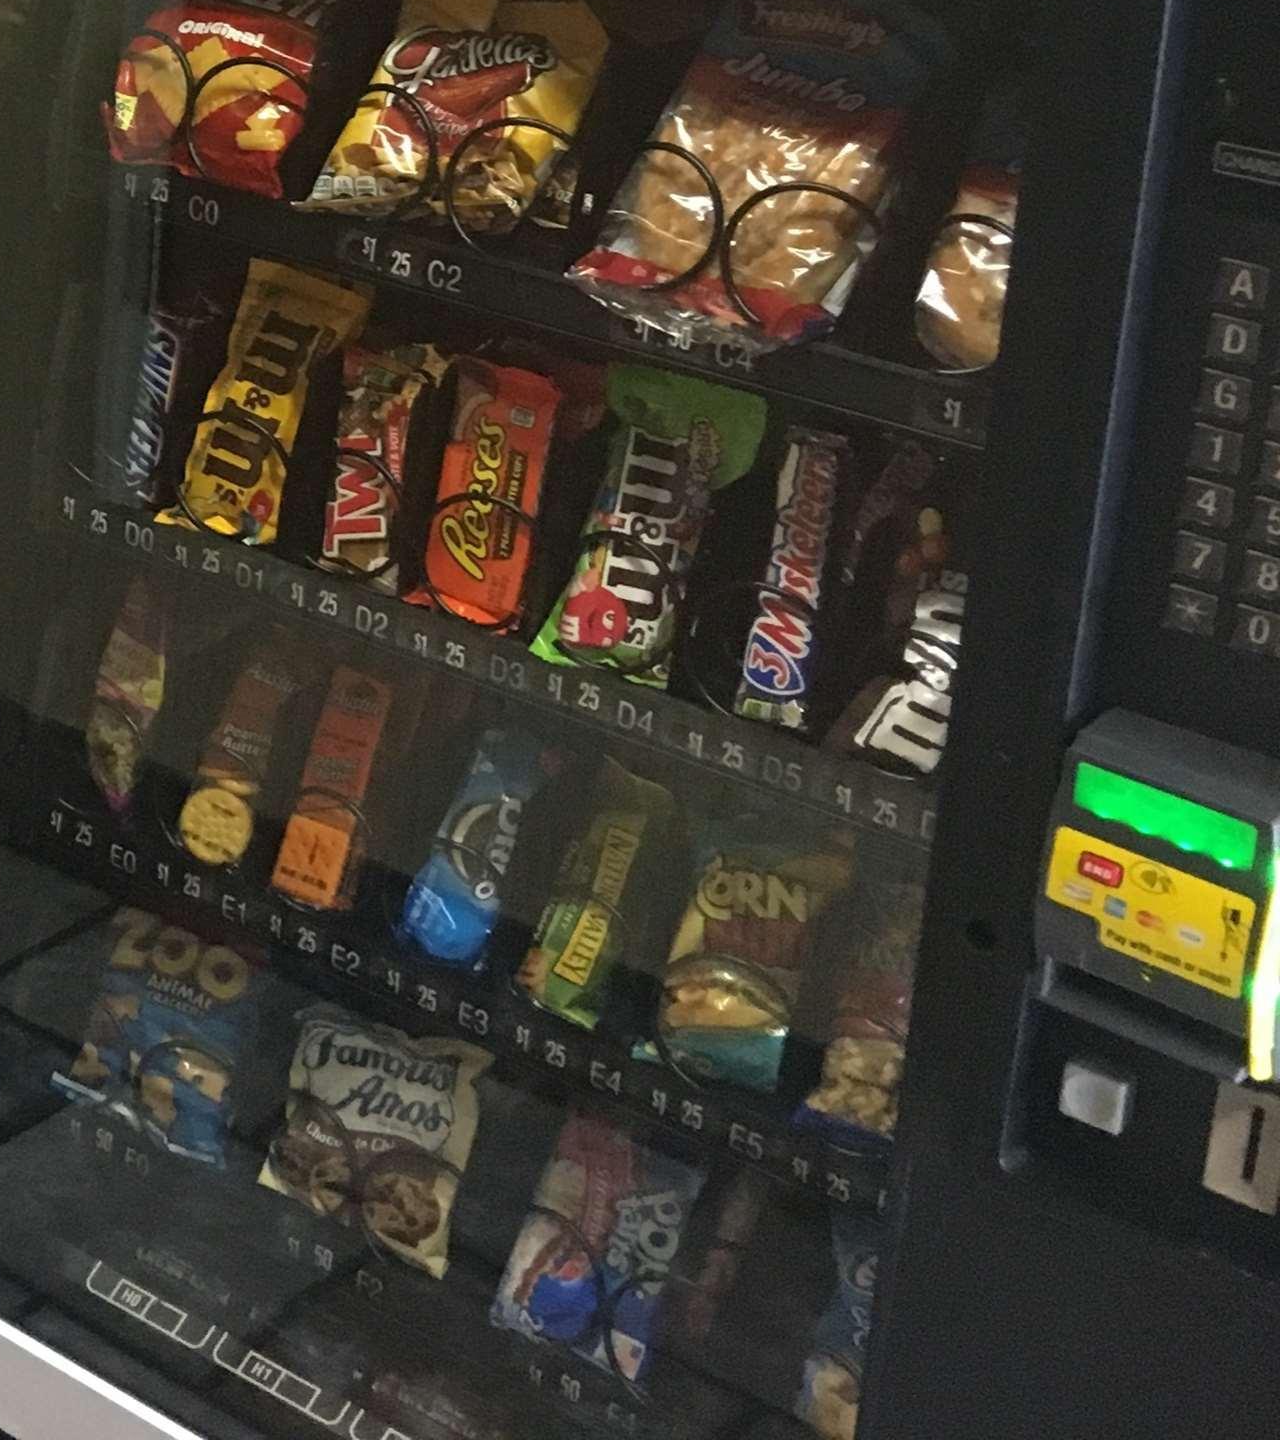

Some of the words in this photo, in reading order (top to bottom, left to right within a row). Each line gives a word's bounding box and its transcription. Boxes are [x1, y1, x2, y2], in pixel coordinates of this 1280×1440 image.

[188, 194, 220, 226] C0
[427, 259, 463, 293] C2
[1229, 269, 1254, 302] A
[1222, 323, 1248, 355] D
[1214, 378, 1239, 411] G
[1211, 434, 1224, 463] 1
[1196, 489, 1218, 517] 4
[124, 520, 155, 552] D0
[235, 562, 264, 591] D1
[1190, 541, 1212, 571] 7
[1256, 561, 1280, 592] 8
[354, 605, 389, 635] D2
[748, 646, 791, 690] 3
[617, 699, 655, 735] D4
[110, 843, 138, 875] E0
[221, 894, 246, 922] E1
[331, 943, 361, 976] E2
[458, 1001, 489, 1037] E3
[302, 1027, 457, 1093] Famous
[590, 1061, 622, 1096] E4
[335, 1074, 450, 1133] Amos
[728, 1122, 764, 1160] E5
